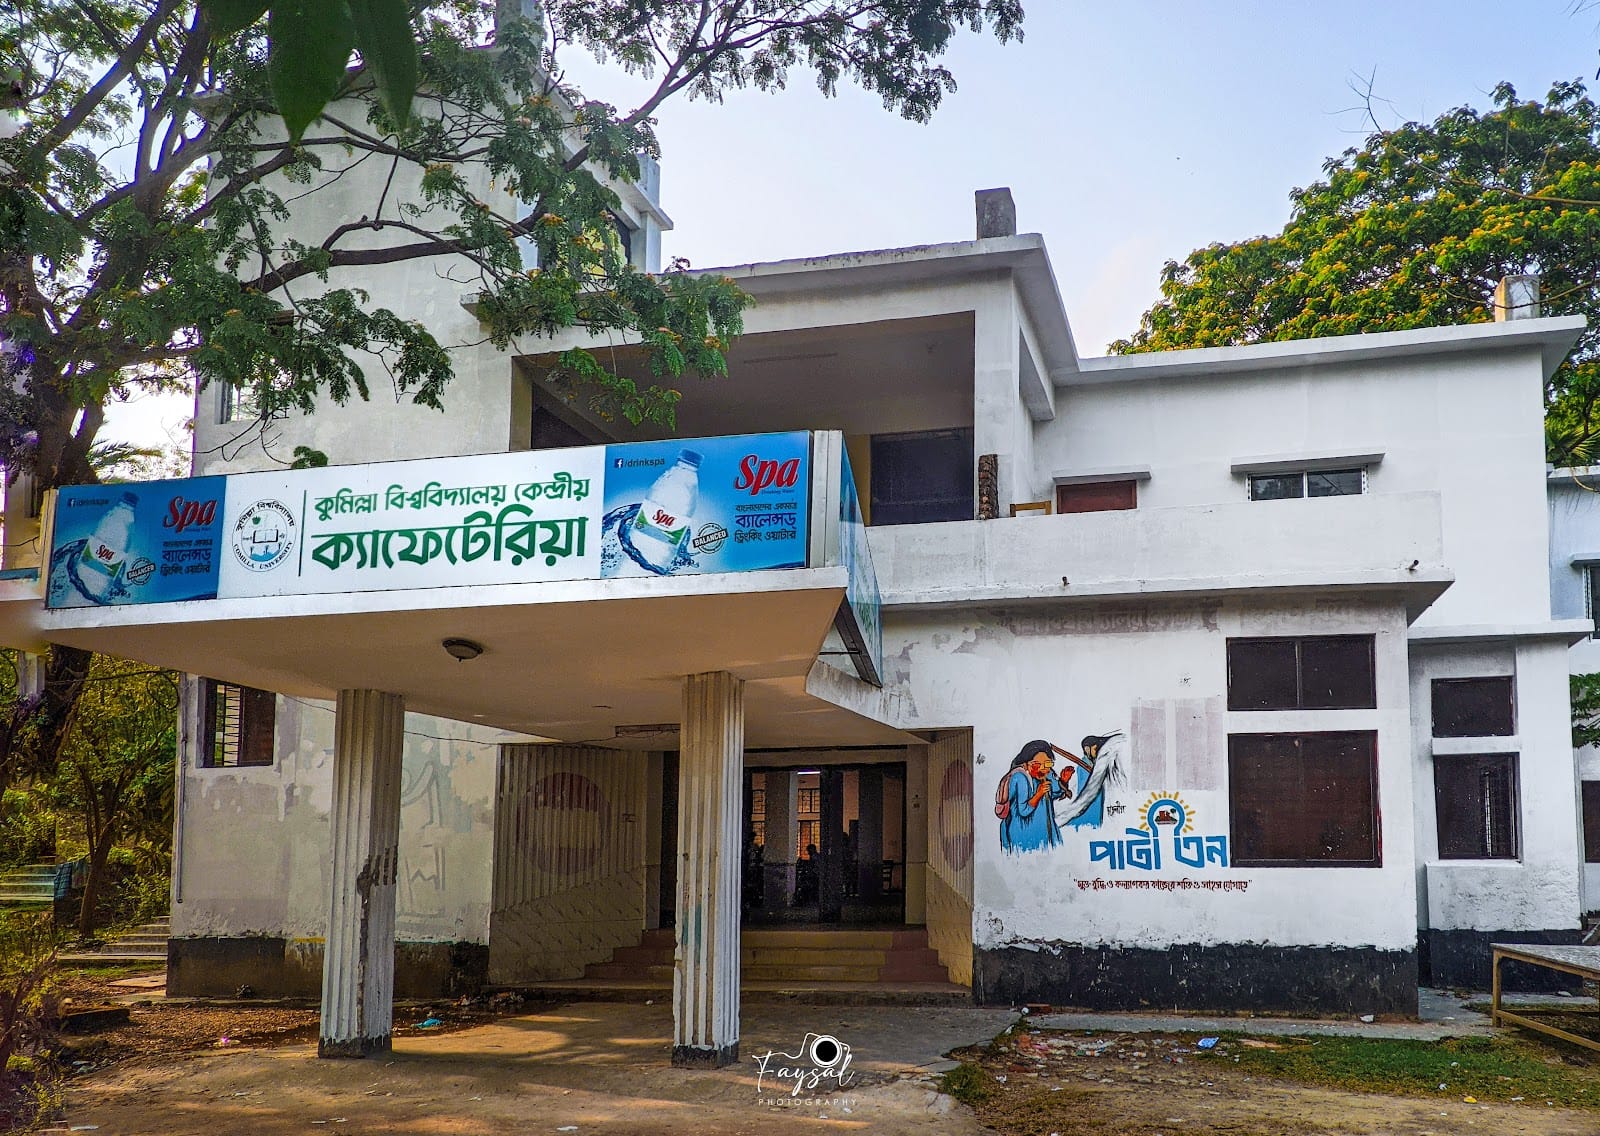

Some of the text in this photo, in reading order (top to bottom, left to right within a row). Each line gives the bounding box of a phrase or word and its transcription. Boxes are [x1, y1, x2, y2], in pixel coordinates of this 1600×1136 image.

[735, 454, 801, 496] Spa
[163, 495, 218, 533] Spa
[314, 471, 591, 521] কুমিল্লা বিশ্ববিদ্যালয় কেন্দ্রীয়
[652, 509, 677, 526] Spa
[96, 544, 115, 561] Spa
[311, 503, 589, 571] ক্যাফেটেরিয়া
[694, 529, 727, 547] BALANCED
